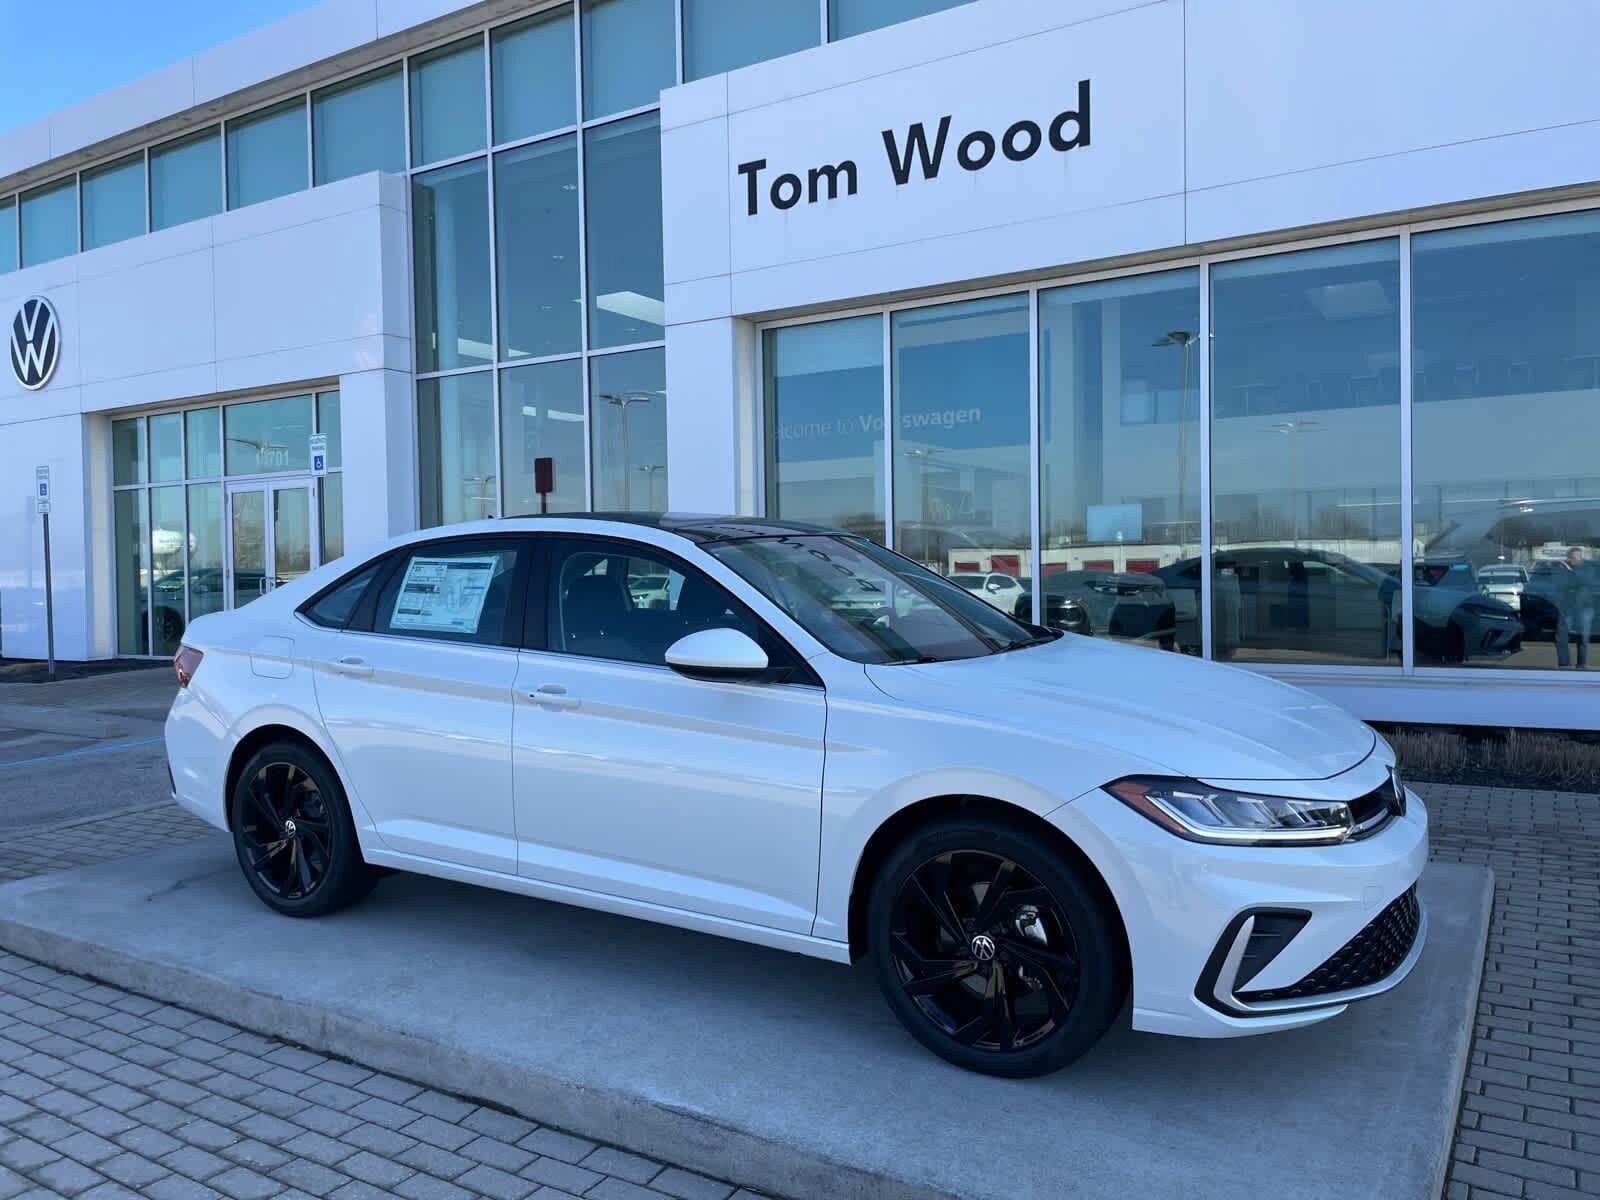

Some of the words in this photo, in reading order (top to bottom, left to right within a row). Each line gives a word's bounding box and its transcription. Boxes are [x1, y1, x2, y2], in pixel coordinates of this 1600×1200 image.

[738, 158, 858, 216] Tom
[881, 79, 1091, 185] Wood
[11, 297, 58, 387] VW
[774, 421, 833, 441] lcome
[859, 408, 982, 432] Voswagen
